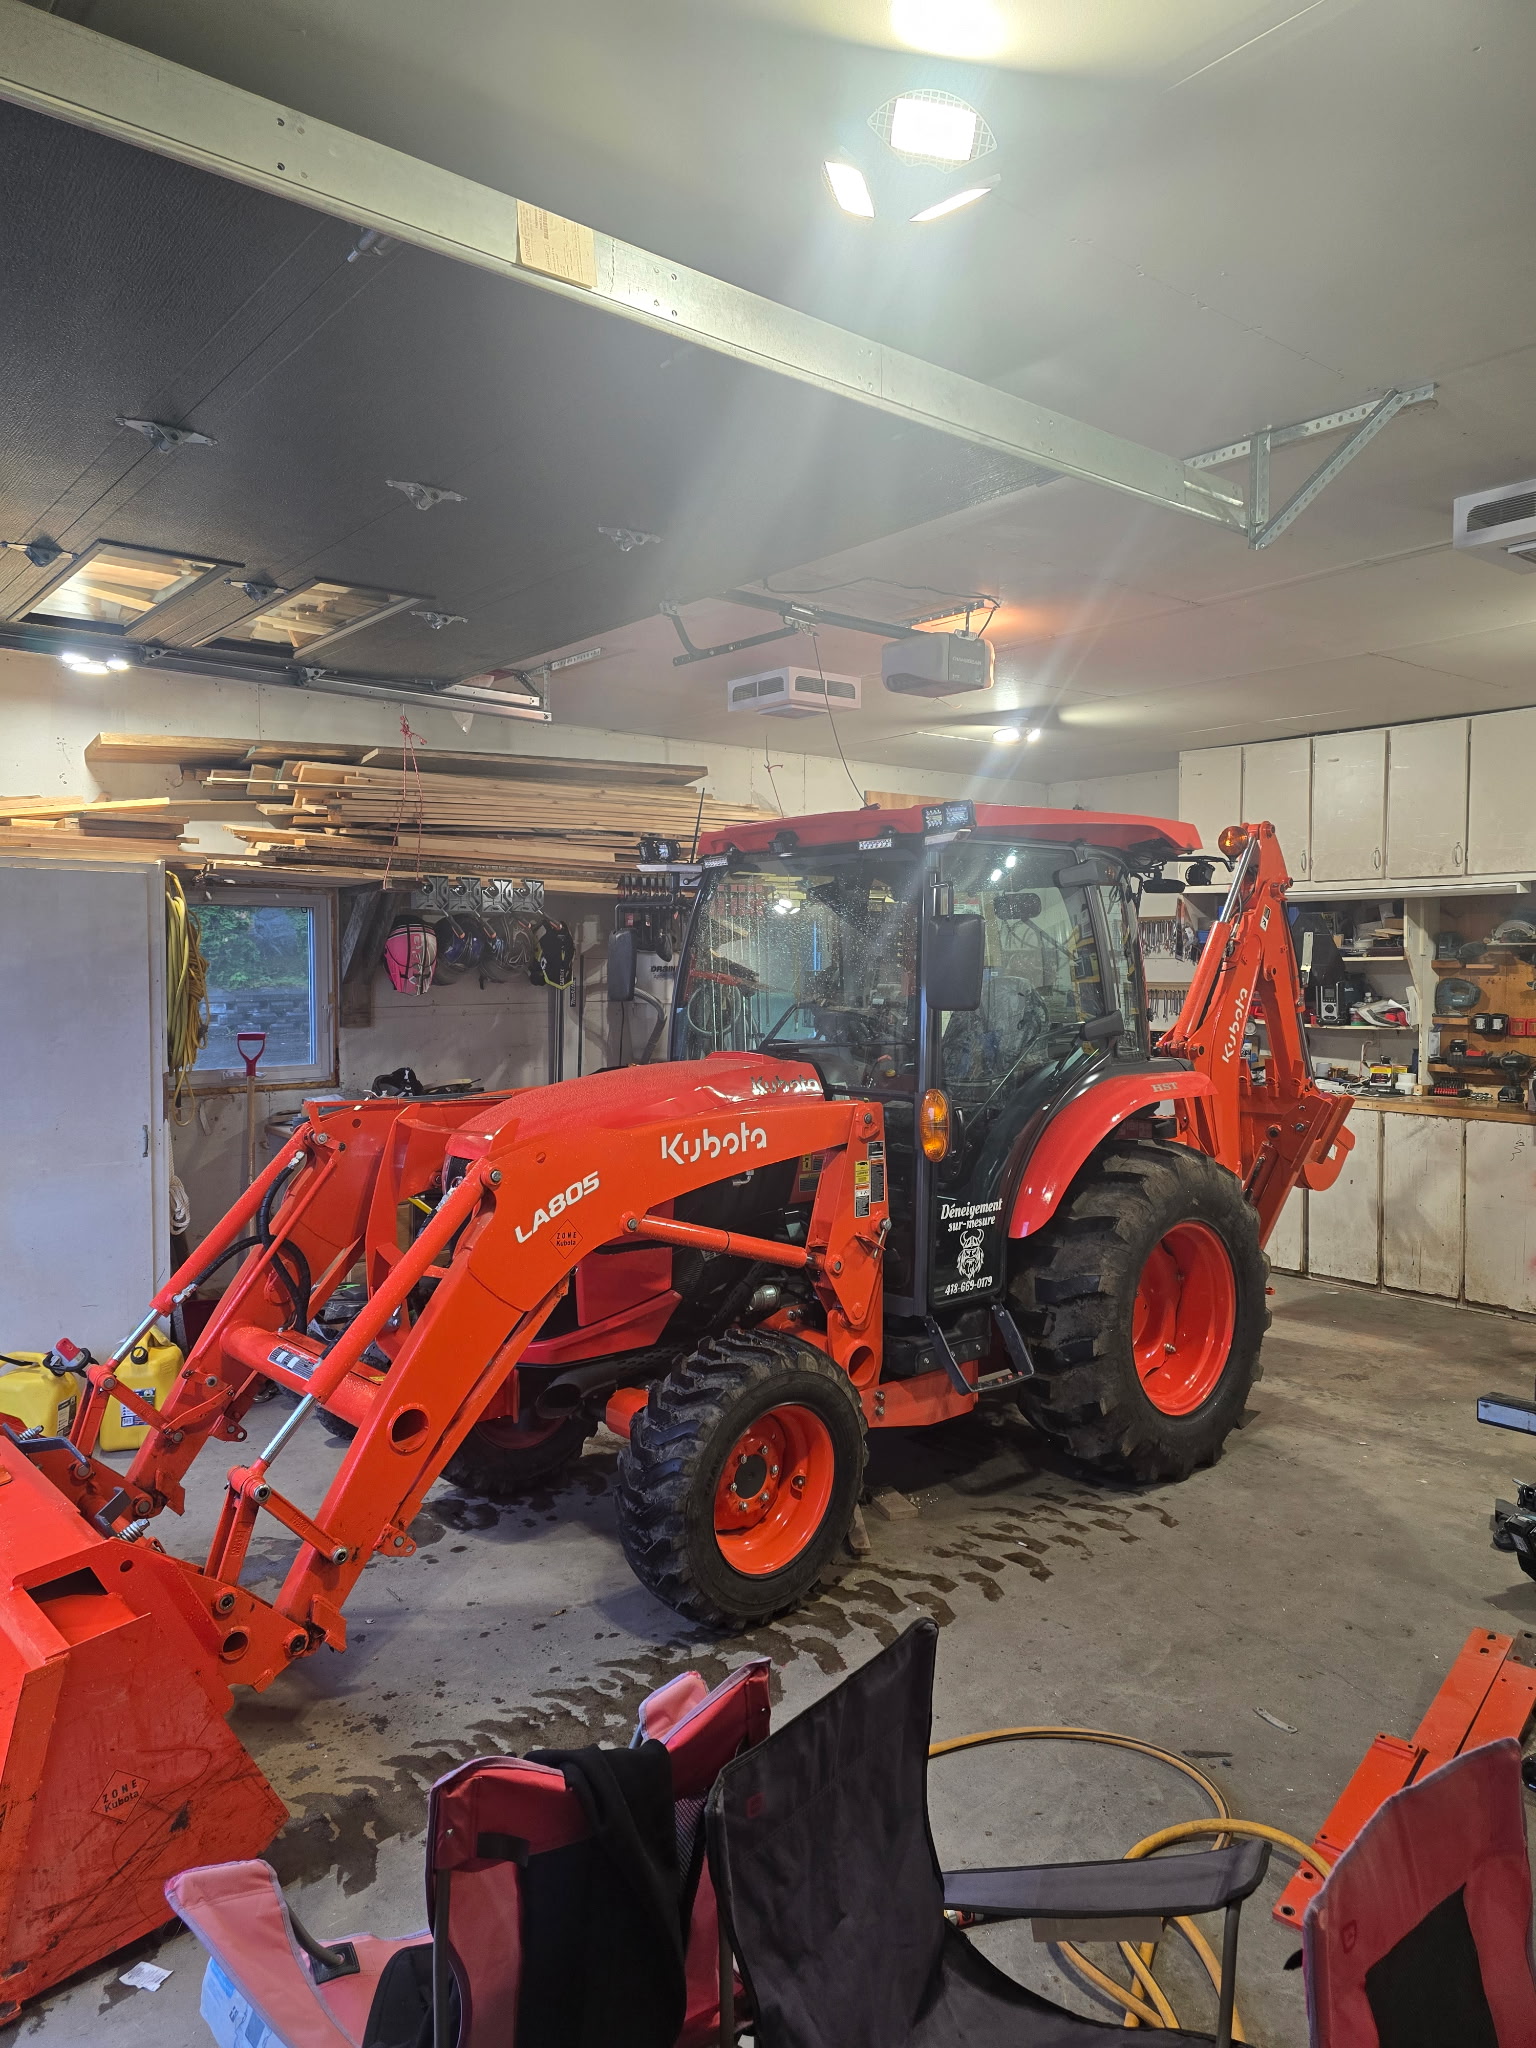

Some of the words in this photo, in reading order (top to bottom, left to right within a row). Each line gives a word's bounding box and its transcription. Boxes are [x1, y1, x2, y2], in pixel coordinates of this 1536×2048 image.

[1222, 988, 1248, 1063] Kubota
[751, 1075, 822, 1095] Kubota
[1151, 1081, 1179, 1093] HST
[660, 1121, 767, 1165] Kubota
[515, 1171, 600, 1243] LA805
[941, 1198, 1003, 1219] Déneigement
[947, 1215, 996, 1232] sur-mesure
[945, 1276, 993, 1296] 418-669-0179
[102, 1779, 137, 1803] ZONE
[104, 1791, 139, 1812] Kubota
